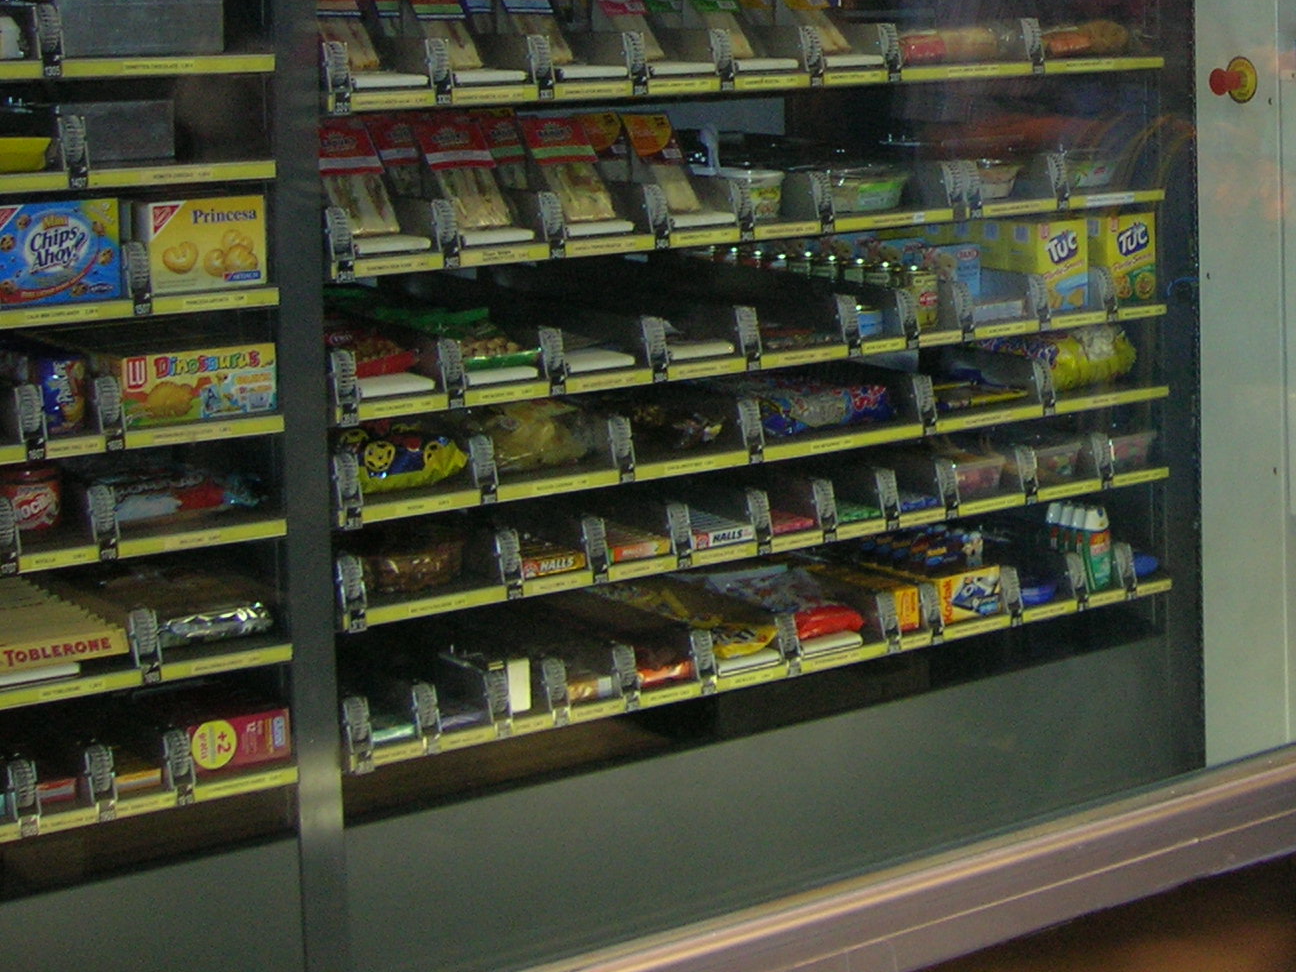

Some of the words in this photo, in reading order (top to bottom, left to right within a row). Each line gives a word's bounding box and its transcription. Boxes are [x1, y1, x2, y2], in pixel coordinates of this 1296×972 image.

[192, 206, 258, 225] Princesa
[30, 228, 79, 253] Chips
[127, 360, 147, 389] LU
[712, 528, 744, 544] HALLS
[541, 556, 575, 572] HALLS
[3, 636, 113, 667] TOBLERONE
